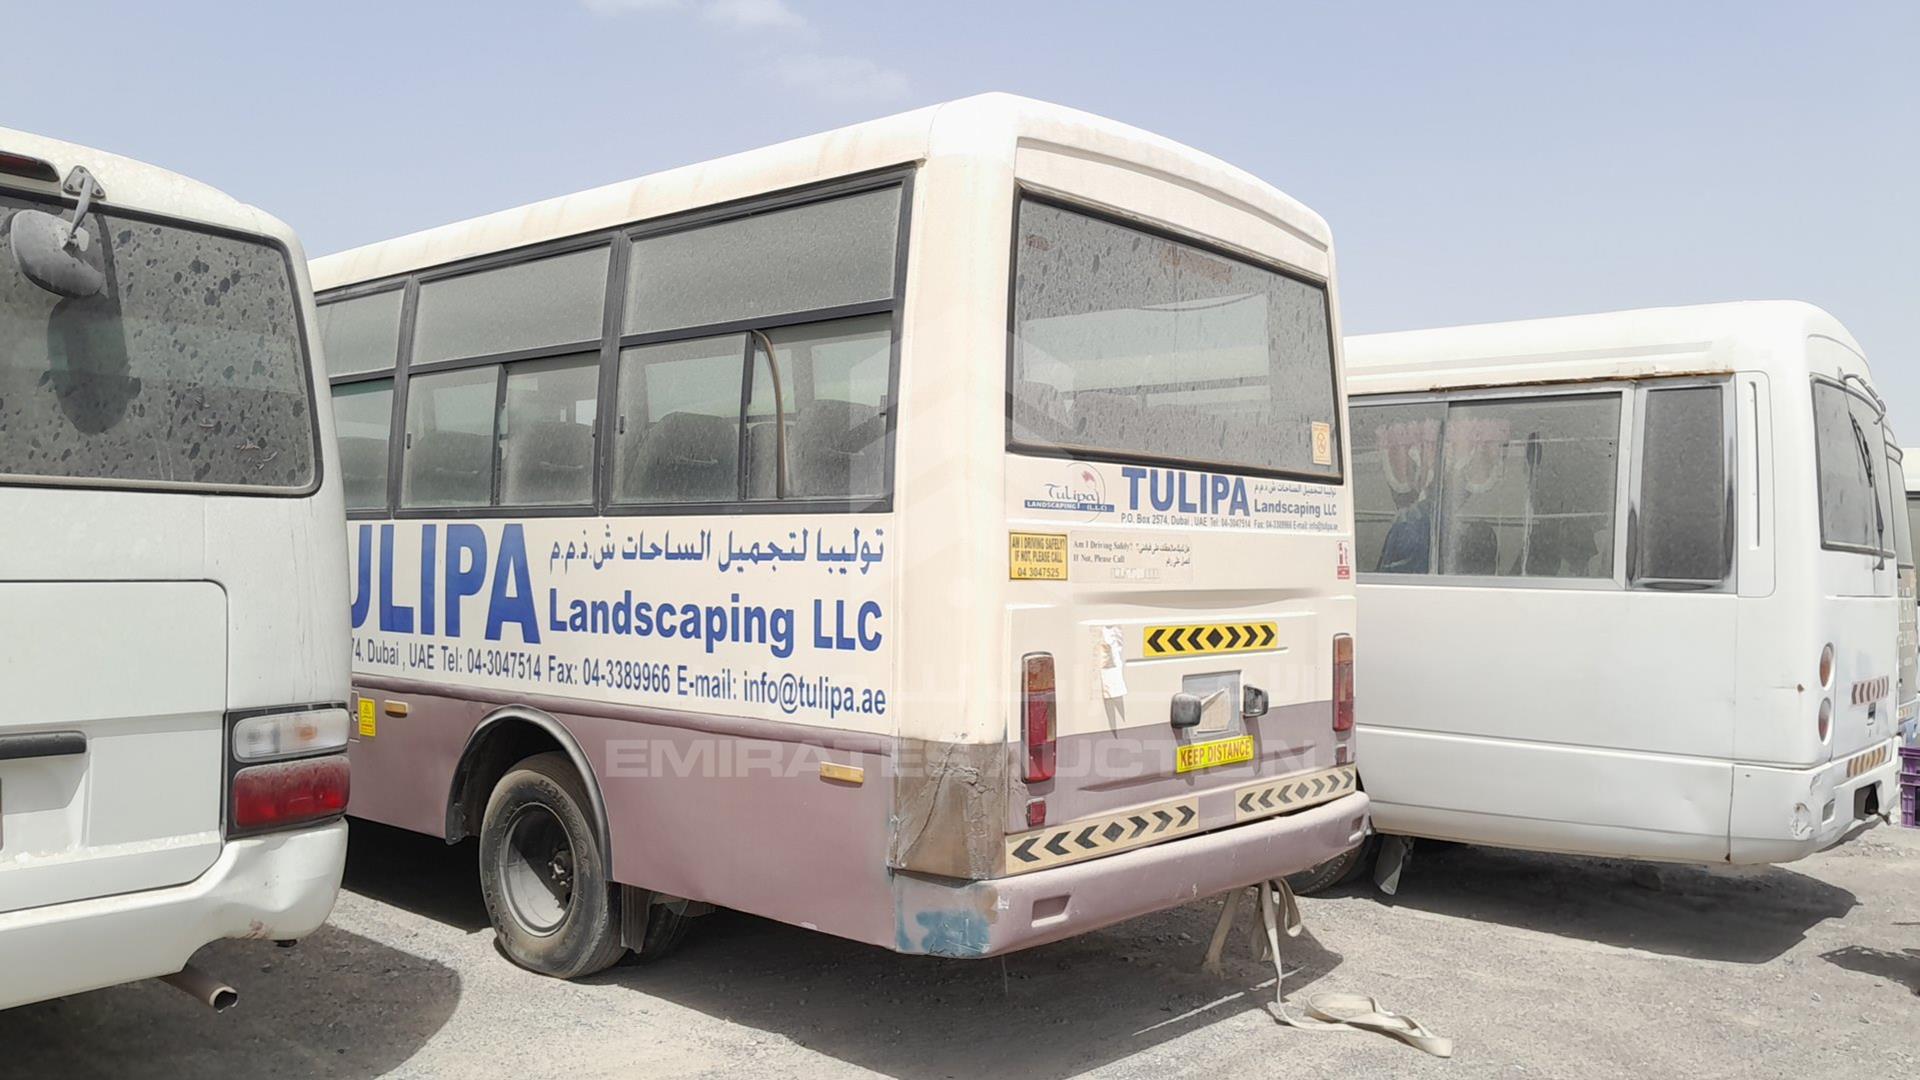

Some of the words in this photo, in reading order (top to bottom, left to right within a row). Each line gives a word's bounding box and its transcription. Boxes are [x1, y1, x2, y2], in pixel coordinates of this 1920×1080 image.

[1043, 483, 1098, 502] Tulipa
[1121, 466, 1250, 516] TULIPA
[1026, 501, 1077, 510] LANDSCAPING
[1254, 499, 1321, 518] Landscaping
[1323, 503, 1337, 516] LLC
[1136, 514, 1150, 524] Box
[1194, 517, 1207, 527] UAE
[621, 527, 711, 561] الساحات
[718, 528, 808, 573] لتجميل
[816, 528, 884, 575] توليبا
[1024, 537, 1044, 549] DRIVING
[1090, 541, 1112, 551] Driving
[1094, 554, 1112, 563] Please
[1113, 554, 1126, 563] Call
[550, 588, 794, 658] Landscaping
[813, 598, 883, 651] LLC
[367, 638, 400, 666] Dubai
[409, 643, 435, 670] UAE
[441, 645, 463, 673] Tel:
[467, 648, 541, 680] 04-3047514
[548, 654, 578, 685] Fax:
[583, 657, 671, 694] 04-3389966
[677, 664, 737, 700] E-mail:
[743, 671, 887, 718] info@tulipa.ae
[1180, 747, 1204, 767] KEEP
[1207, 739, 1250, 763] DISTANCE
